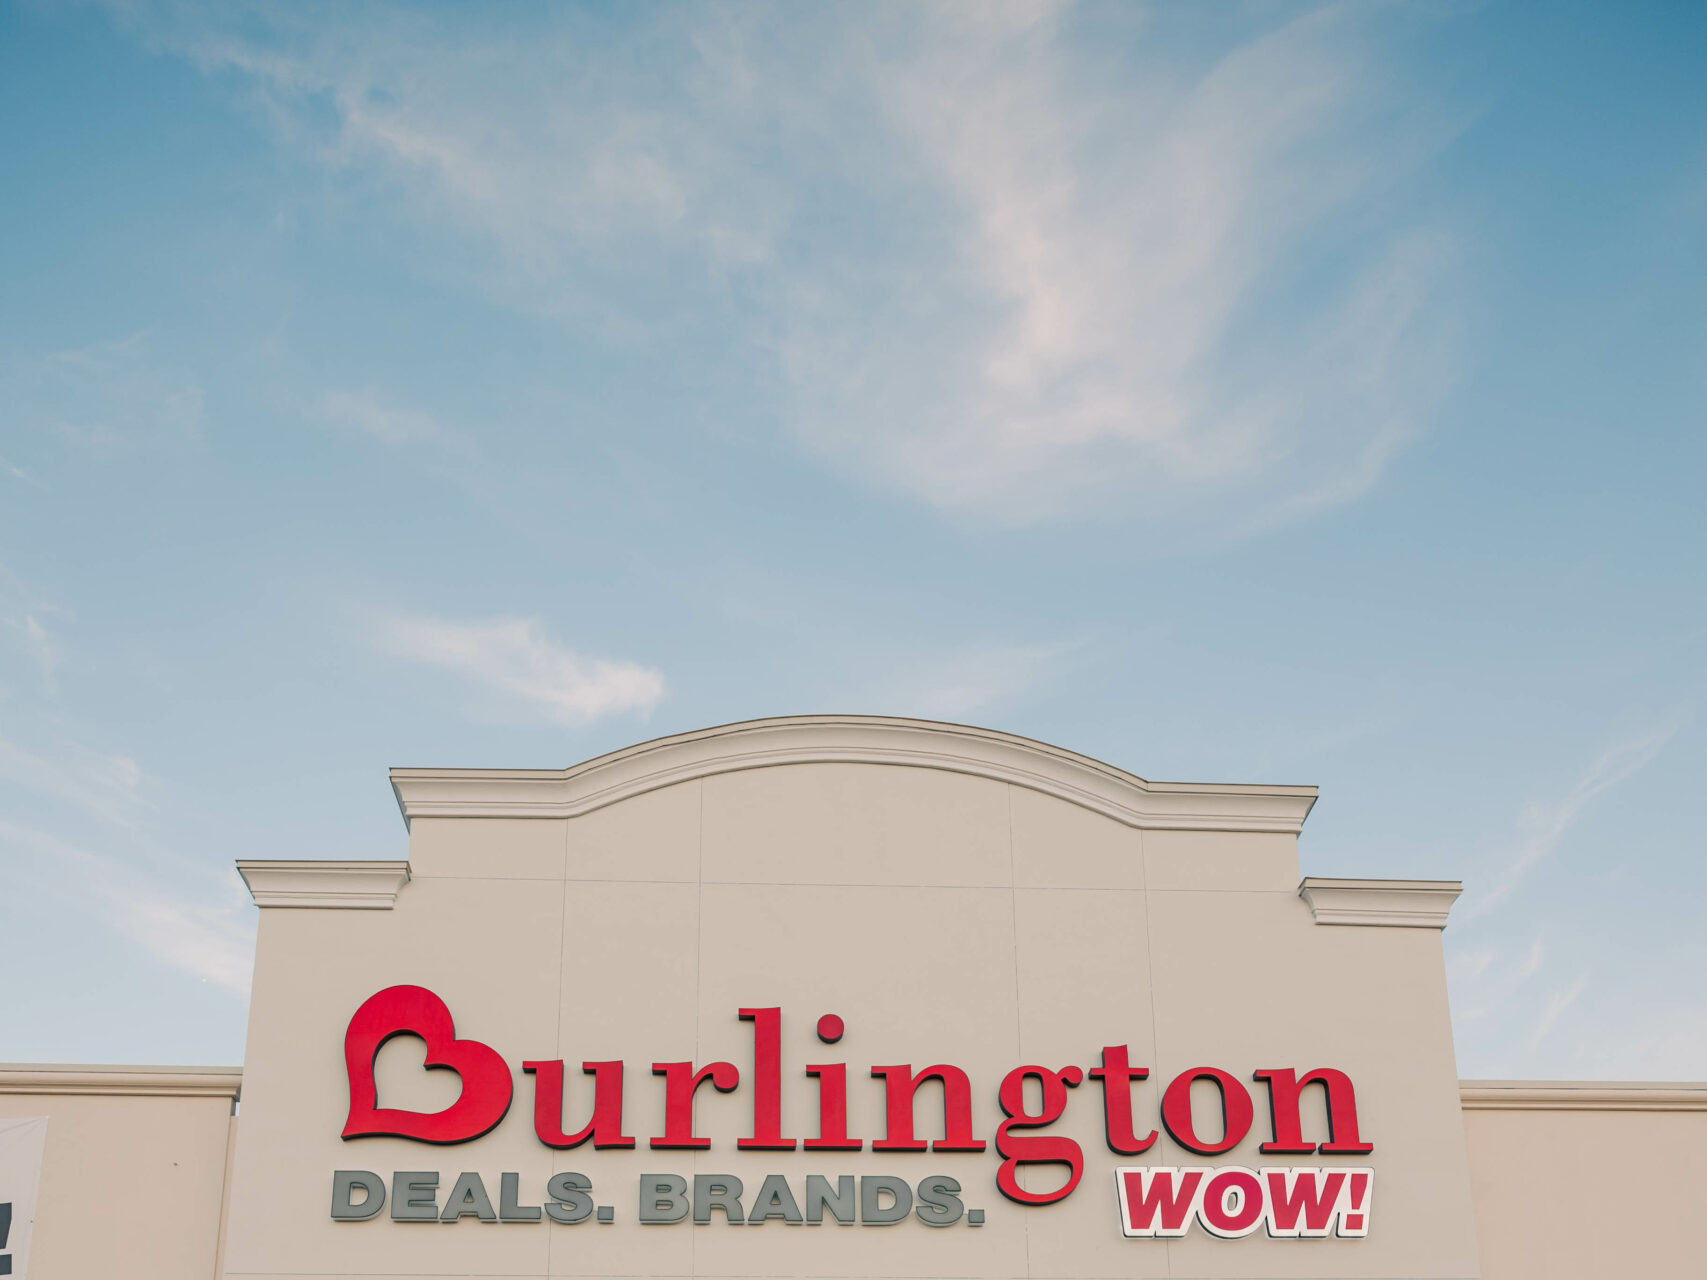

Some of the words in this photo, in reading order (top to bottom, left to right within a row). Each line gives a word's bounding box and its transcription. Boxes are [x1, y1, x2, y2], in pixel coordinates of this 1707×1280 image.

[341, 984, 1375, 1206] Burlington
[330, 1170, 615, 1224] DEALS.
[639, 1173, 986, 1228] BRANDS.
[1118, 1168, 1373, 1236] WOW!
